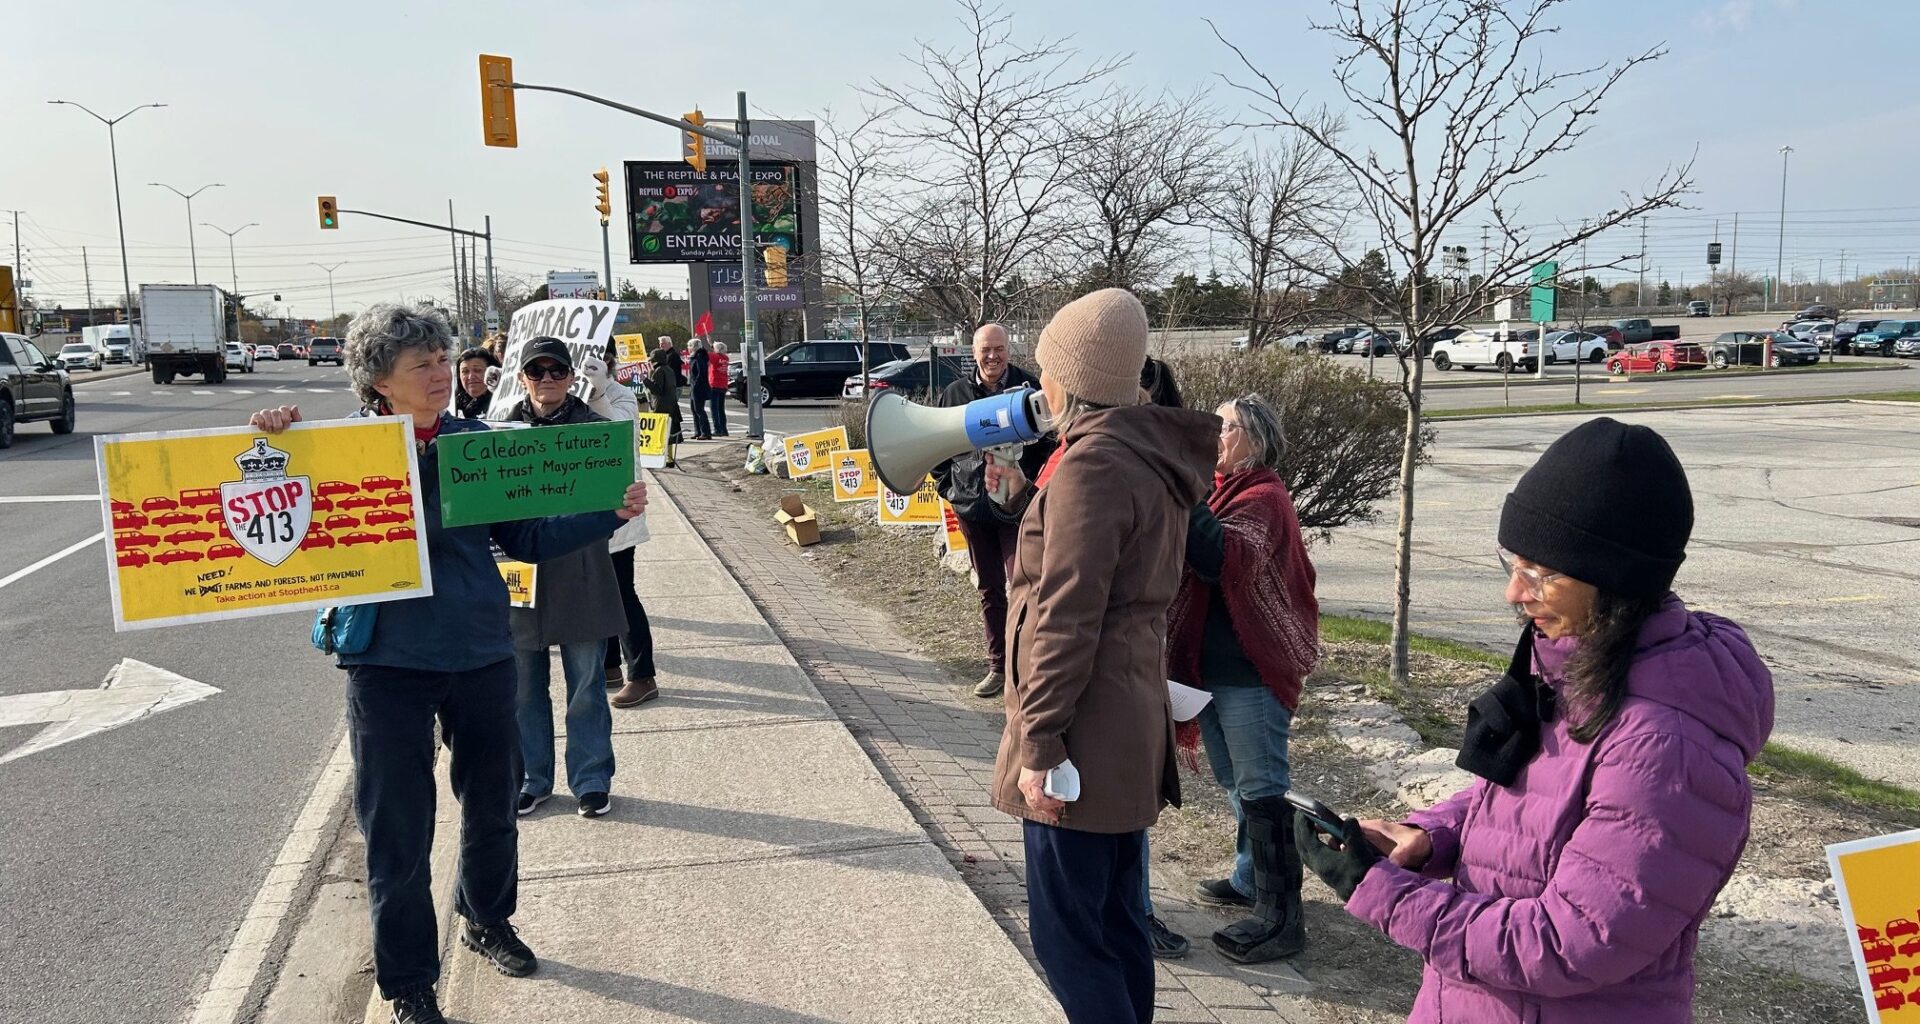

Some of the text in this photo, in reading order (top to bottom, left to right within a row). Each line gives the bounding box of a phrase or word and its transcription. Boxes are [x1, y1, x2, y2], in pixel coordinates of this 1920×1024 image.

[644, 171, 665, 180] THE
[667, 171, 707, 180] REPTILE
[710, 171, 718, 180] &
[755, 171, 782, 180] EXPO
[639, 187, 663, 196] REPTILE
[666, 235, 742, 248] ENTRANC
[718, 295, 737, 303] 6900
[775, 294, 797, 302] ROAD
[463, 432, 610, 462] Caledon's future?
[814, 437, 840, 450] OPEN UP
[791, 450, 810, 460] STOP
[816, 448, 830, 458] HWY
[796, 457, 808, 467] 413
[450, 456, 623, 484] Don't trust Mayor Groves
[839, 470, 861, 479] STOP
[505, 479, 576, 500] with that!
[844, 478, 858, 489] 413
[228, 481, 303, 523] STOP
[917, 492, 935, 503] HWY
[890, 498, 905, 511] 413
[235, 511, 294, 544] THE 413
[185, 588, 197, 596] WE
[225, 581, 252, 591] FARMS
[254, 579, 271, 588] AND
[273, 575, 308, 586] FORESTS,
[310, 573, 325, 582] NOT
[326, 569, 365, 580] PAVEMENT
[215, 595, 236, 603] Take
[238, 592, 266, 601] action
[278, 584, 340, 597] Stopthe413.ca
